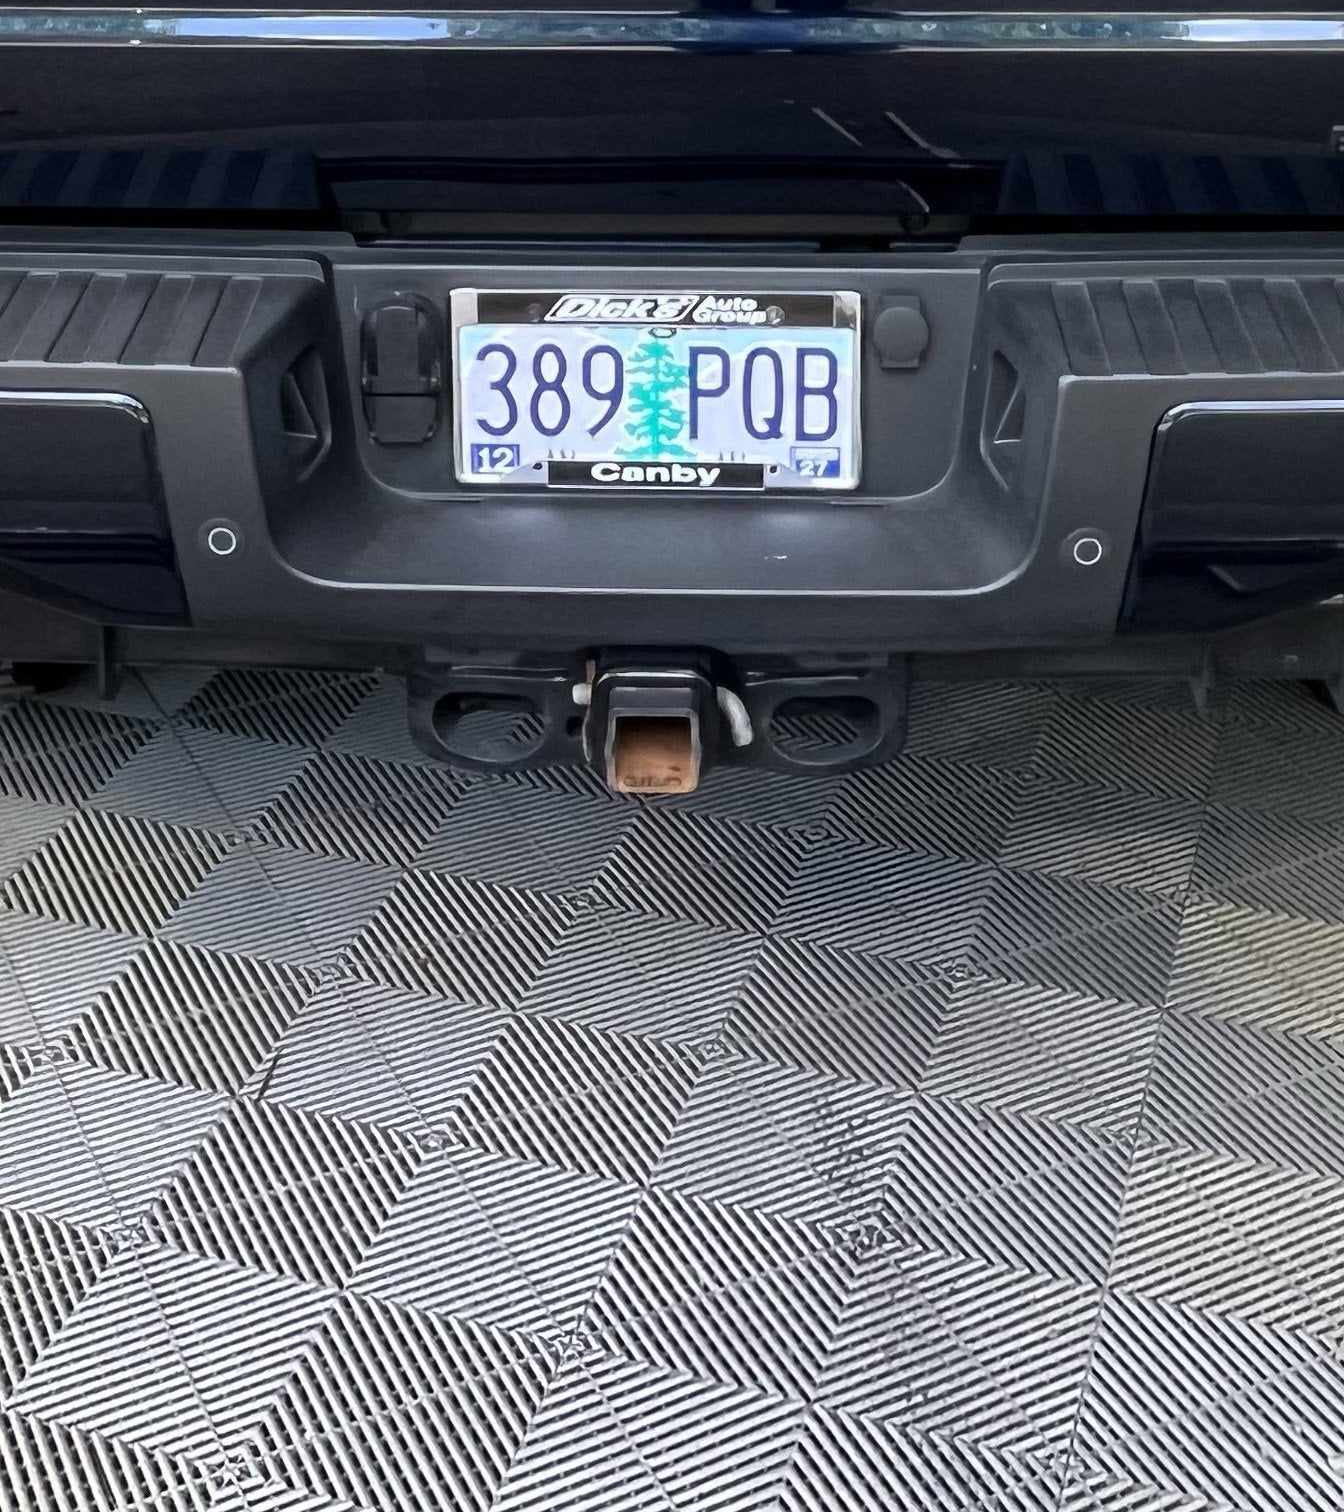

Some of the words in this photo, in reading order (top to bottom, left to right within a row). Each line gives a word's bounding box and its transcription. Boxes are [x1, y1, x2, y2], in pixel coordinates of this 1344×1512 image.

[704, 295, 758, 311] Auto
[692, 310, 768, 325] Group
[478, 447, 516, 474] 12
[799, 459, 828, 477] 27
[590, 461, 721, 486] Canby
